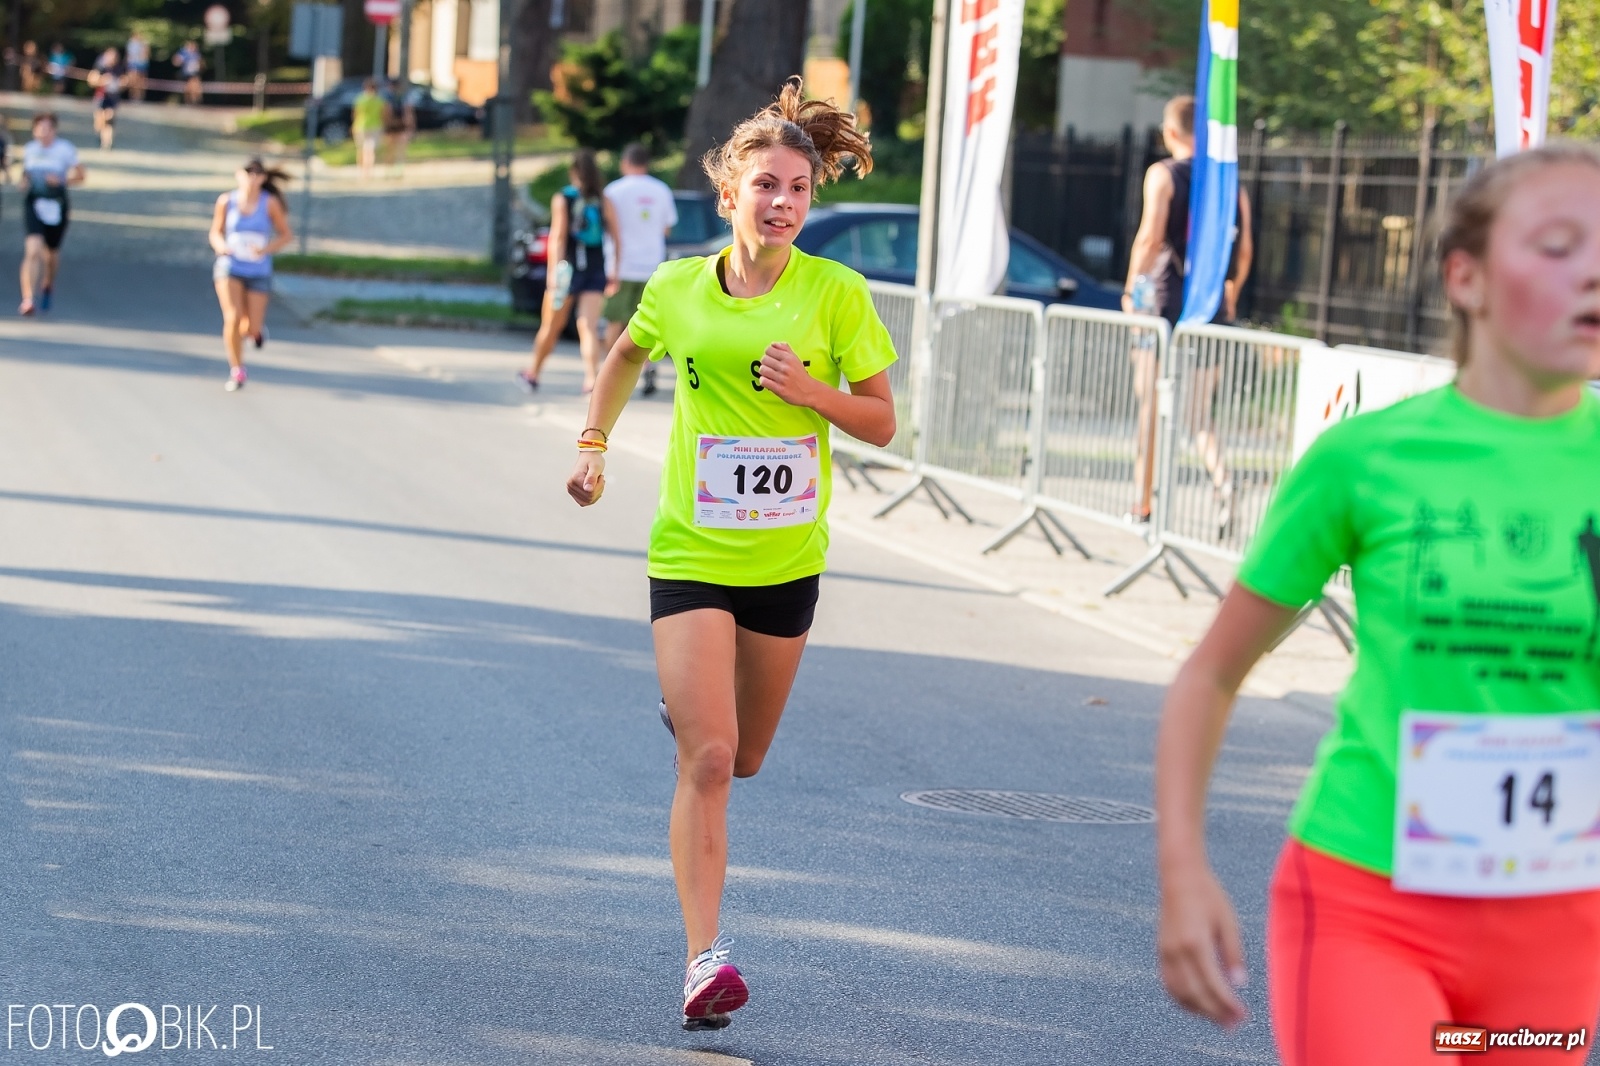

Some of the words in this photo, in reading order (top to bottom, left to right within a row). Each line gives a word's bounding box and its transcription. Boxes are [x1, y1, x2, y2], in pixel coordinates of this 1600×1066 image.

[686, 357, 700, 390] 5
[733, 464, 793, 495] 120
[1499, 772, 1556, 826] 14
